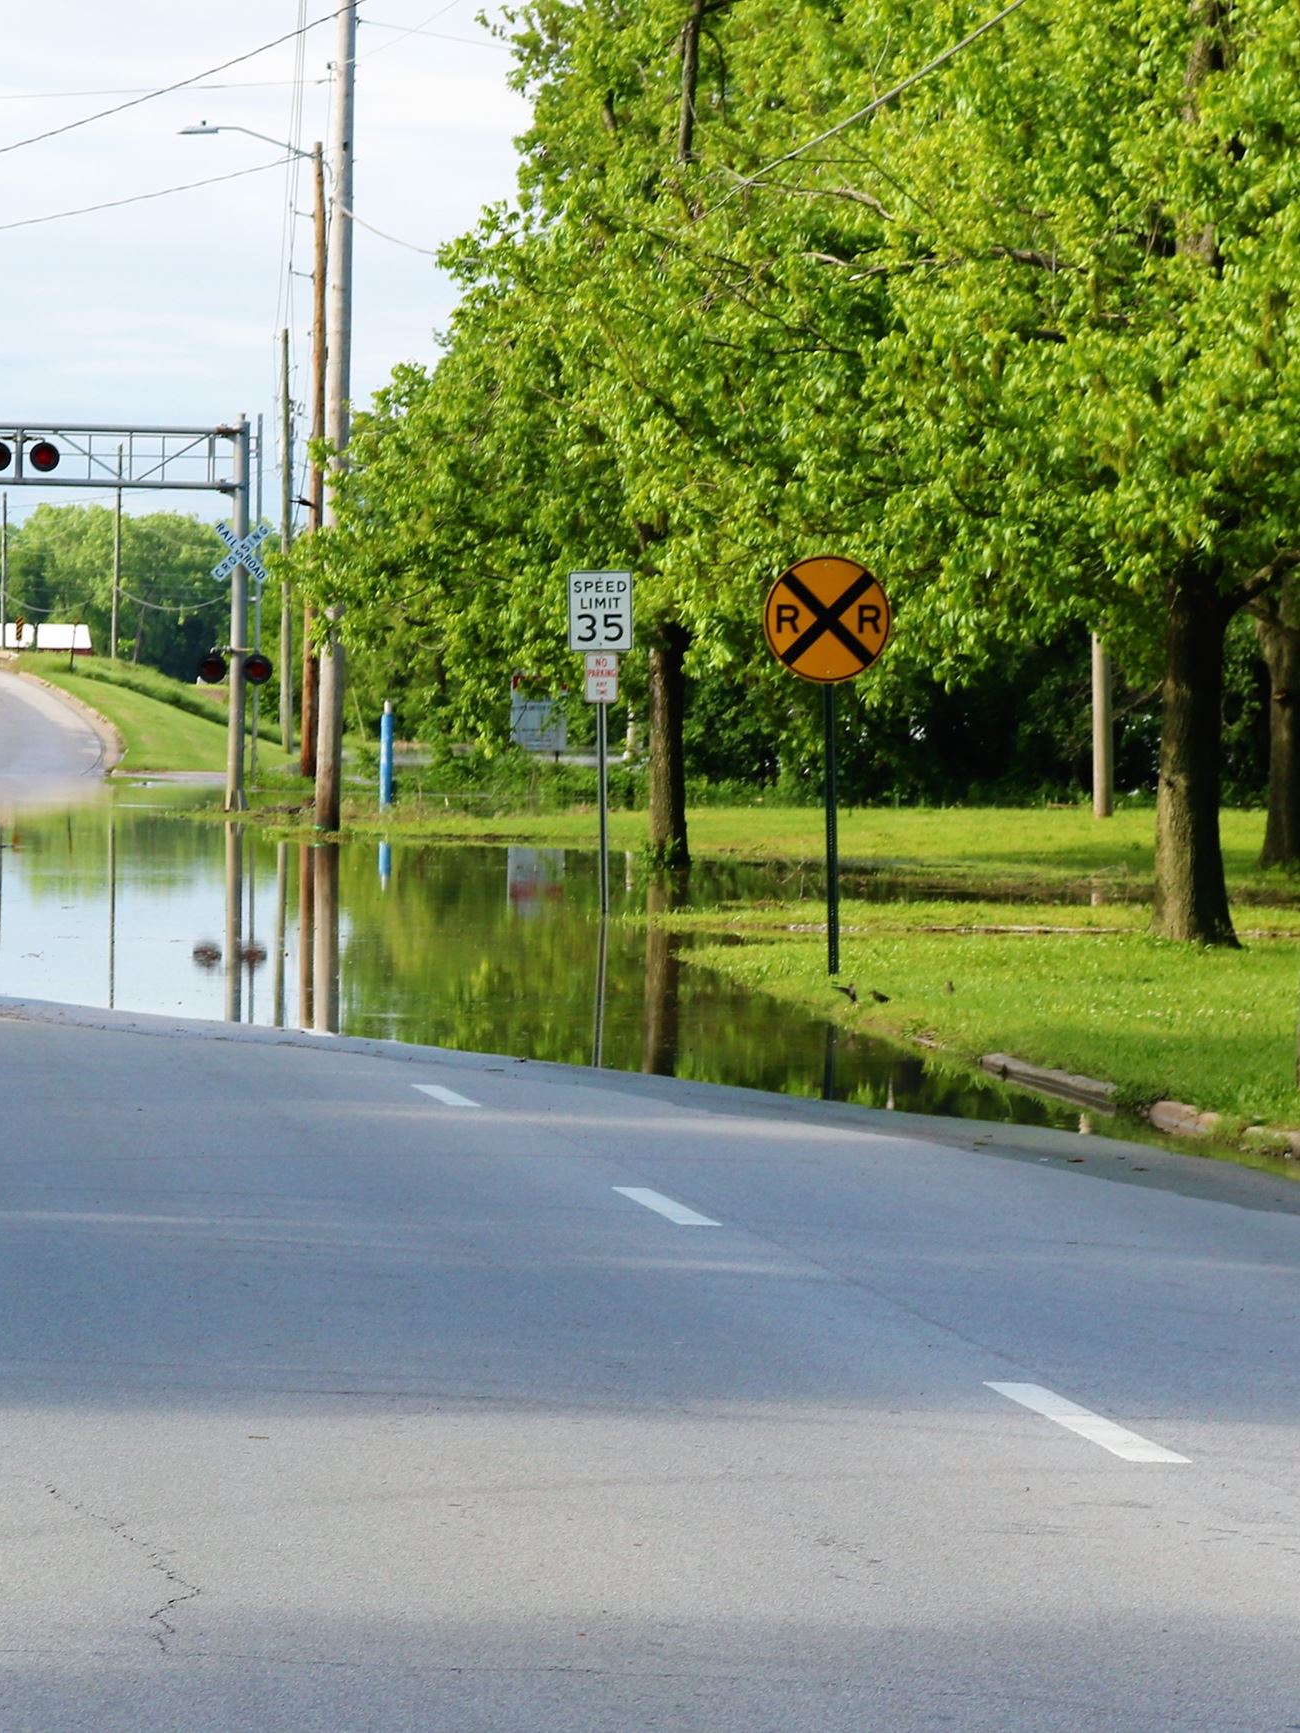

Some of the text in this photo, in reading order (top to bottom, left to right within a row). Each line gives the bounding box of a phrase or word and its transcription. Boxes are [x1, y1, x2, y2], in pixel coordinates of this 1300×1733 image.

[215, 525, 268, 578] CROSSING
[573, 581, 627, 593] SPEED
[580, 597, 621, 609] LIMIT
[776, 604, 881, 634] R R
[577, 613, 624, 642] 35
[596, 658, 608, 667] NO
[587, 669, 617, 678] PARKING
